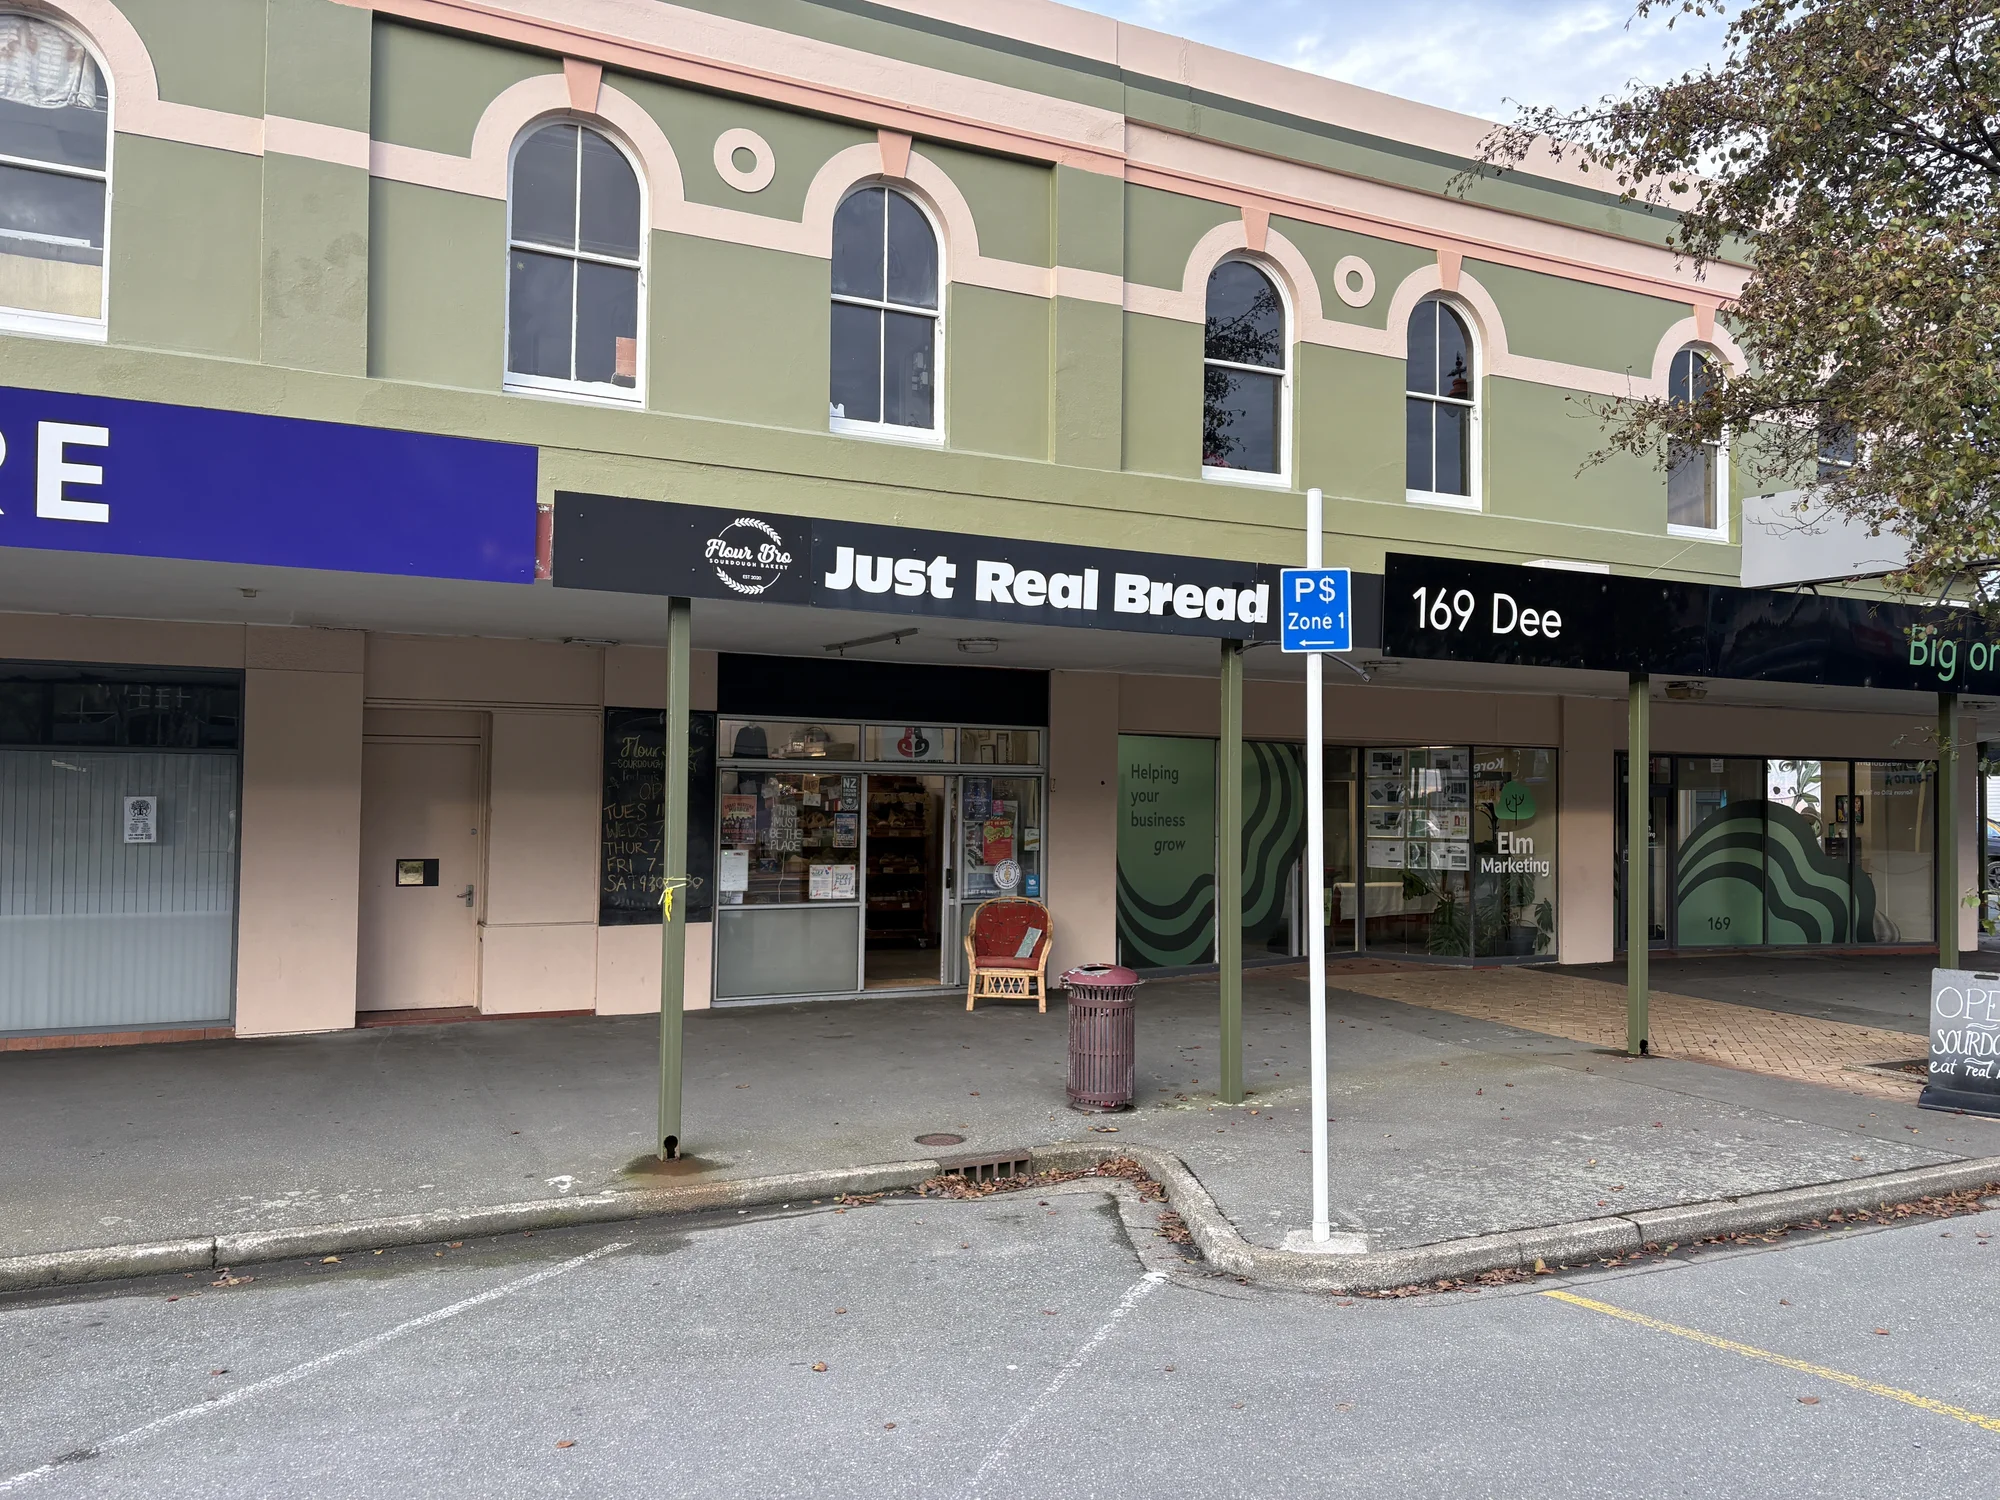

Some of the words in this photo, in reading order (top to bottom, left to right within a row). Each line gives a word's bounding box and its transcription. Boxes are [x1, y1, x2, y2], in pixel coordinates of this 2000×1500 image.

[0, 420, 109, 523] E
[705, 538, 753, 560] Flour
[757, 543, 792, 563] Bro
[709, 558, 757, 567] SOURDOUGH
[760, 562, 788, 570] BAKERY
[825, 545, 957, 599] Just
[975, 559, 1099, 611] Real
[1113, 573, 1270, 624] Bread
[1295, 575, 1336, 604] P$
[1288, 613, 1333, 630] Zone
[1338, 611, 1345, 629] 1
[1412, 586, 1476, 632] 169
[1492, 592, 1562, 639] Dee
[1909, 623, 1957, 681] Big
[620, 734, 662, 758] Flour
[1131, 763, 1179, 784] Helping
[639, 782, 664, 800] OP
[843, 778, 857, 788] NZ
[1130, 791, 1160, 807] your
[603, 803, 648, 821] TUES
[776, 804, 797, 817] THIS
[1131, 810, 1186, 827] business
[773, 817, 799, 828] MUST
[769, 828, 783, 839] BE
[784, 829, 803, 840] THE
[1497, 831, 1534, 855] Elm
[602, 840, 648, 855] THUR
[770, 840, 801, 851] PLACE
[1153, 840, 1187, 856] grow
[606, 857, 633, 873] FRI
[1480, 857, 1550, 877] Marketing
[603, 873, 637, 892] SAT
[1707, 916, 1731, 931] 169
[1935, 986, 2000, 1022] OPE
[1929, 1059, 1957, 1075] eat
[1965, 1060, 1995, 1079] real
